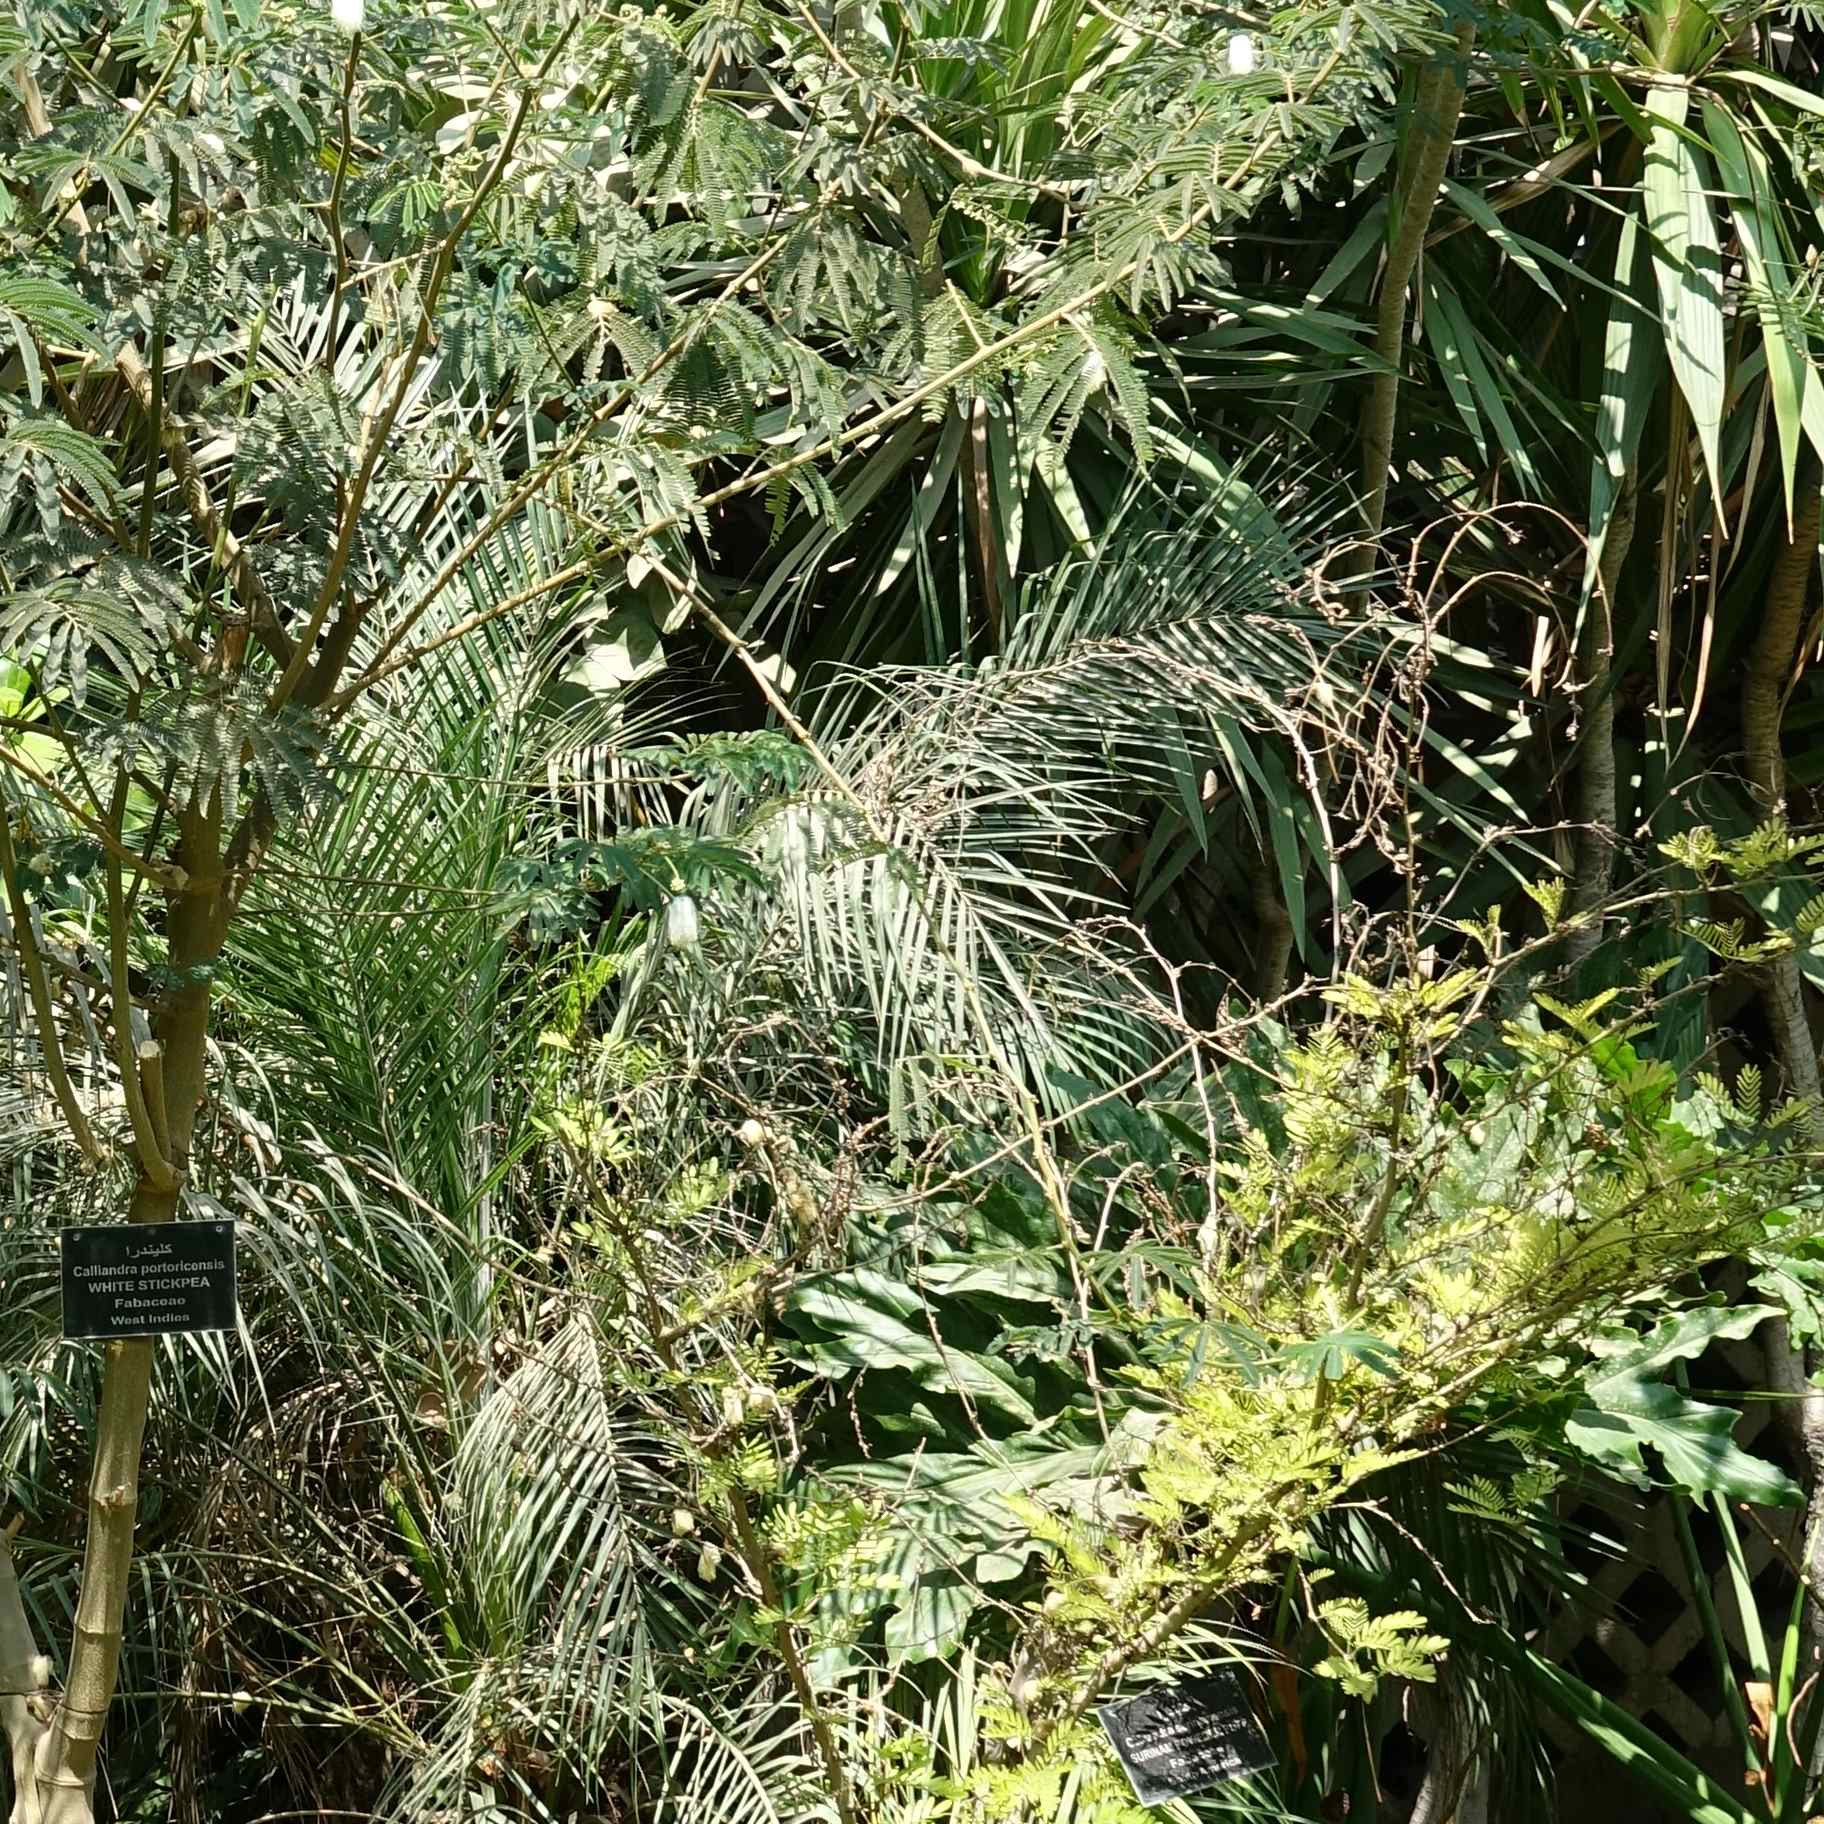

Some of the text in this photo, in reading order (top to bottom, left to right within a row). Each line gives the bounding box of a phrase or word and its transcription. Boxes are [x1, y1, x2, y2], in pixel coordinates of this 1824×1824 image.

[73, 1263, 137, 1277] Calliandra
[88, 1276, 210, 1293] WHITE STICKPEA
[110, 1313, 190, 1326] West Indies
